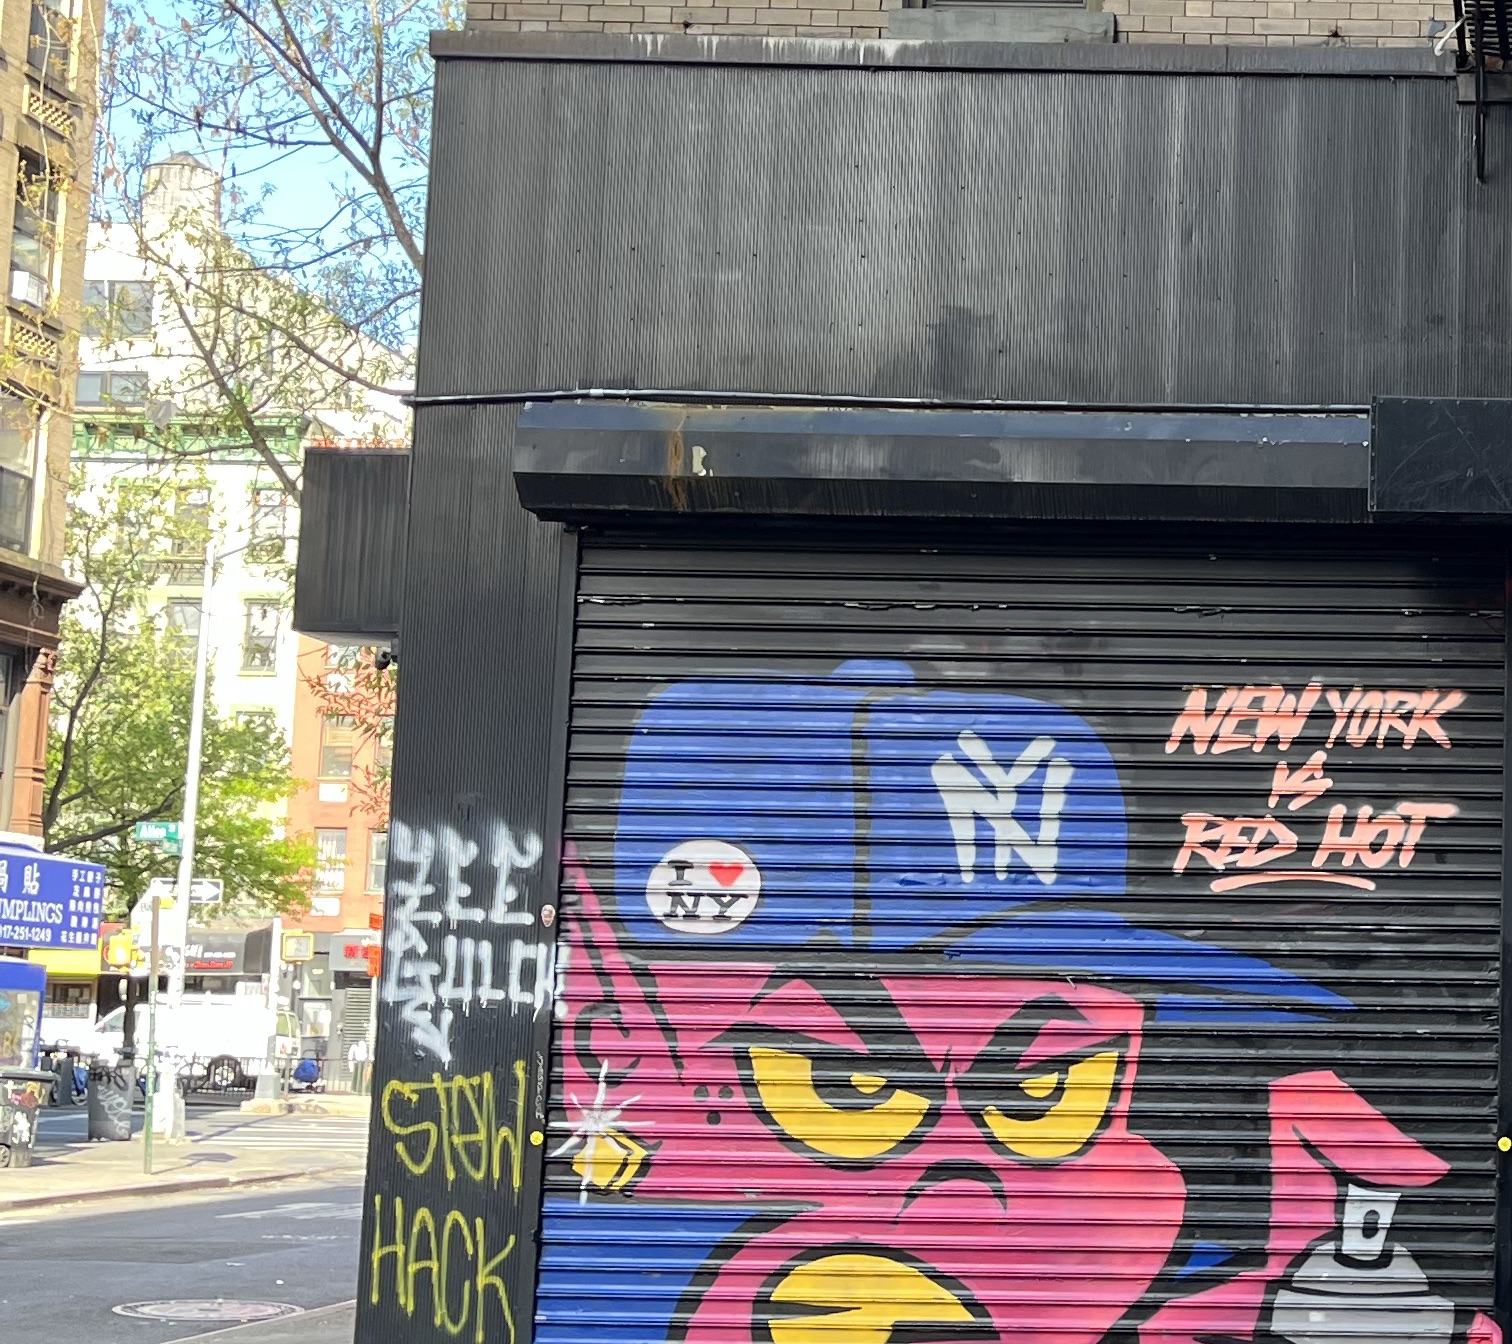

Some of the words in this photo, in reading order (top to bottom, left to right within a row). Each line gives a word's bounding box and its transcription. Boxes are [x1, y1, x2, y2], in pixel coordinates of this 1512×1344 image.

[1165, 680, 1323, 755] NEW
[1326, 689, 1467, 750] YORK
[931, 729, 1075, 884] NY
[1172, 813, 1298, 874] RED
[1311, 803, 1460, 869] HOT
[666, 859, 690, 888] I
[0, 898, 64, 925] MPLINGS
[662, 891, 750, 921] NY
